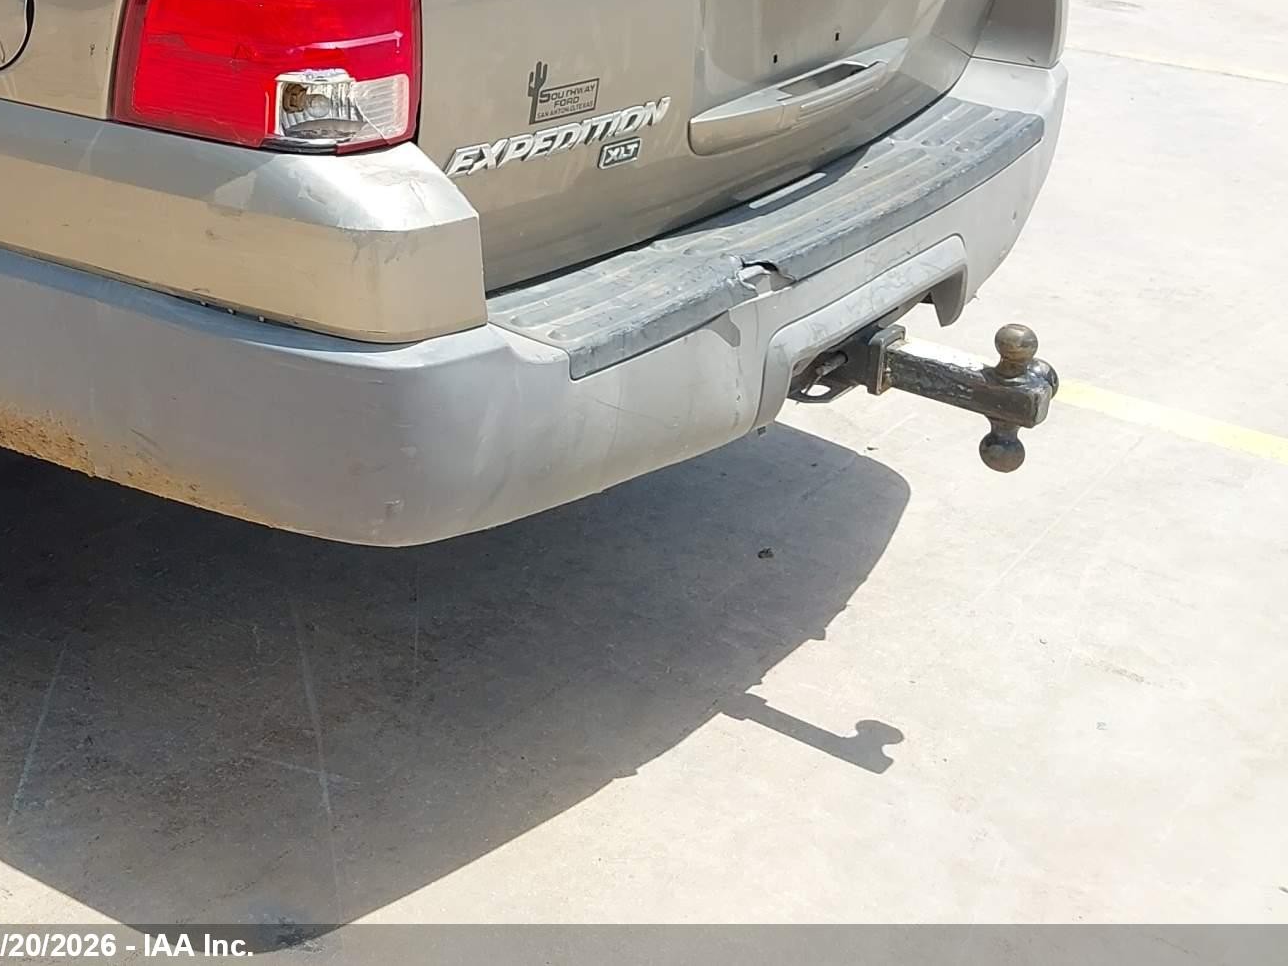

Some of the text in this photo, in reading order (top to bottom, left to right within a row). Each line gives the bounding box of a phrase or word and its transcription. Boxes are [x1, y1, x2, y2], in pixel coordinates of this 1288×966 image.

[553, 96, 580, 108] FORD
[446, 96, 672, 178] EXPEDITION
[604, 142, 639, 164] XLT
